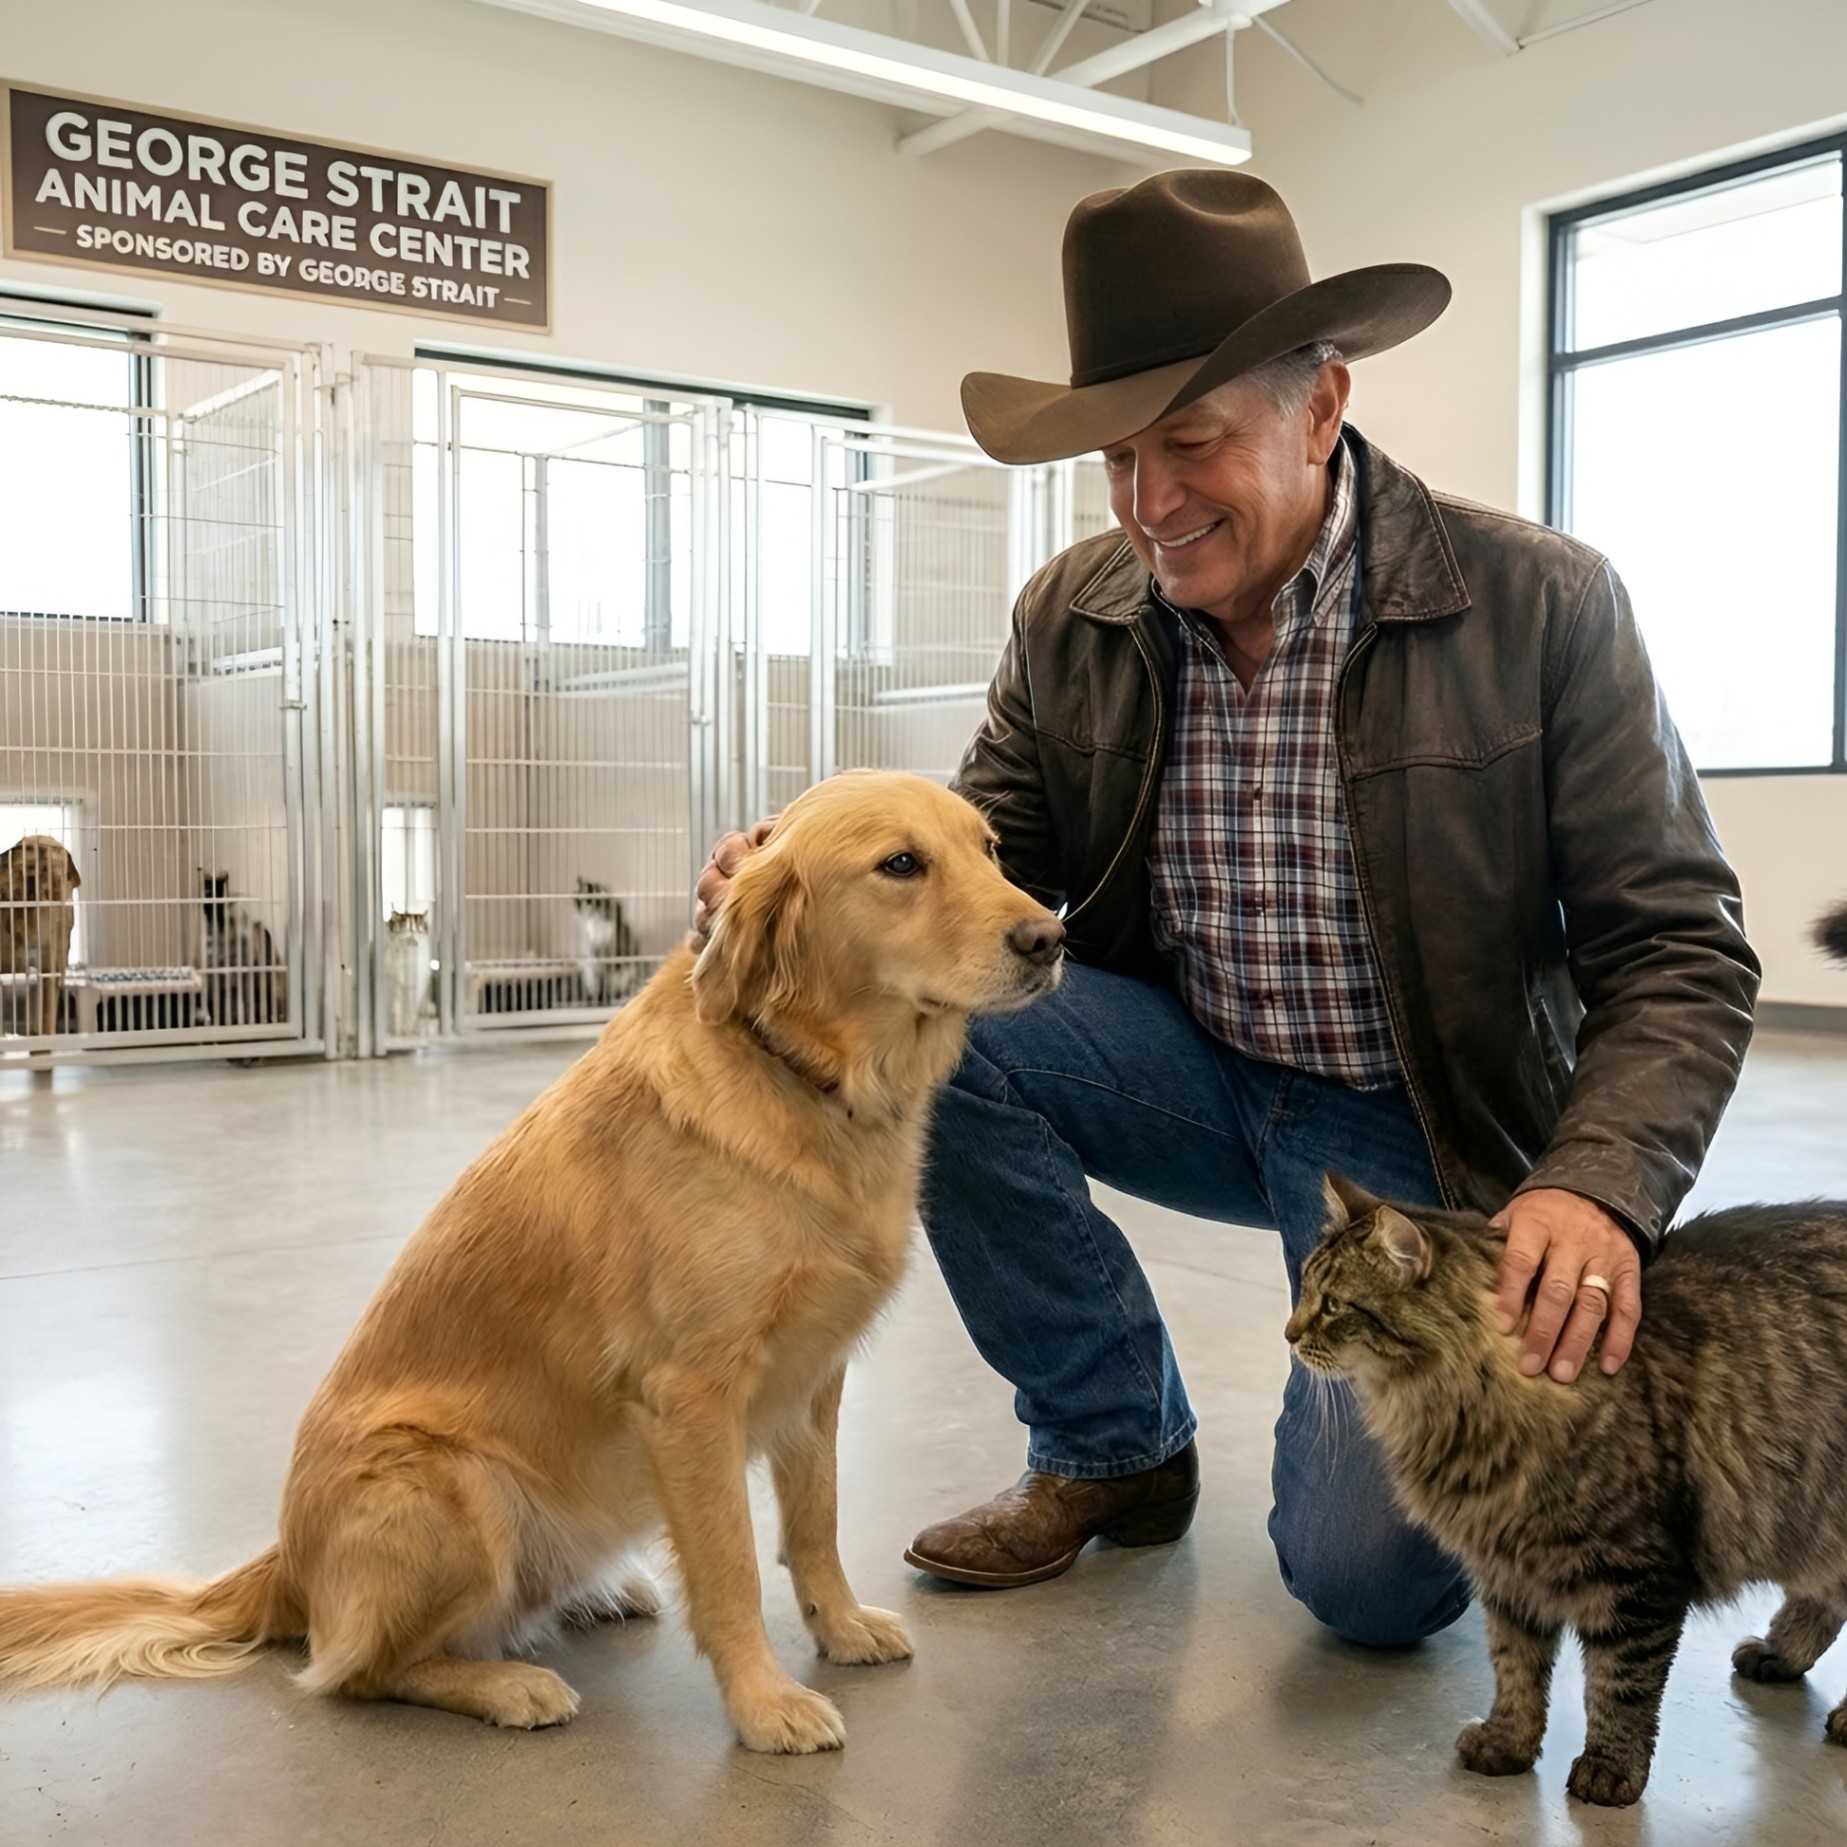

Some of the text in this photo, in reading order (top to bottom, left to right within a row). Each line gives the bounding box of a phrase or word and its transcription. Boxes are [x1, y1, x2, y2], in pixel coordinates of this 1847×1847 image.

[35, 168, 530, 279] ANIMAL CARE CENTER
[45, 111, 521, 234] GEORGE STRAIT
[76, 224, 500, 308] SPONSORED BY GEORGE STRAIT
